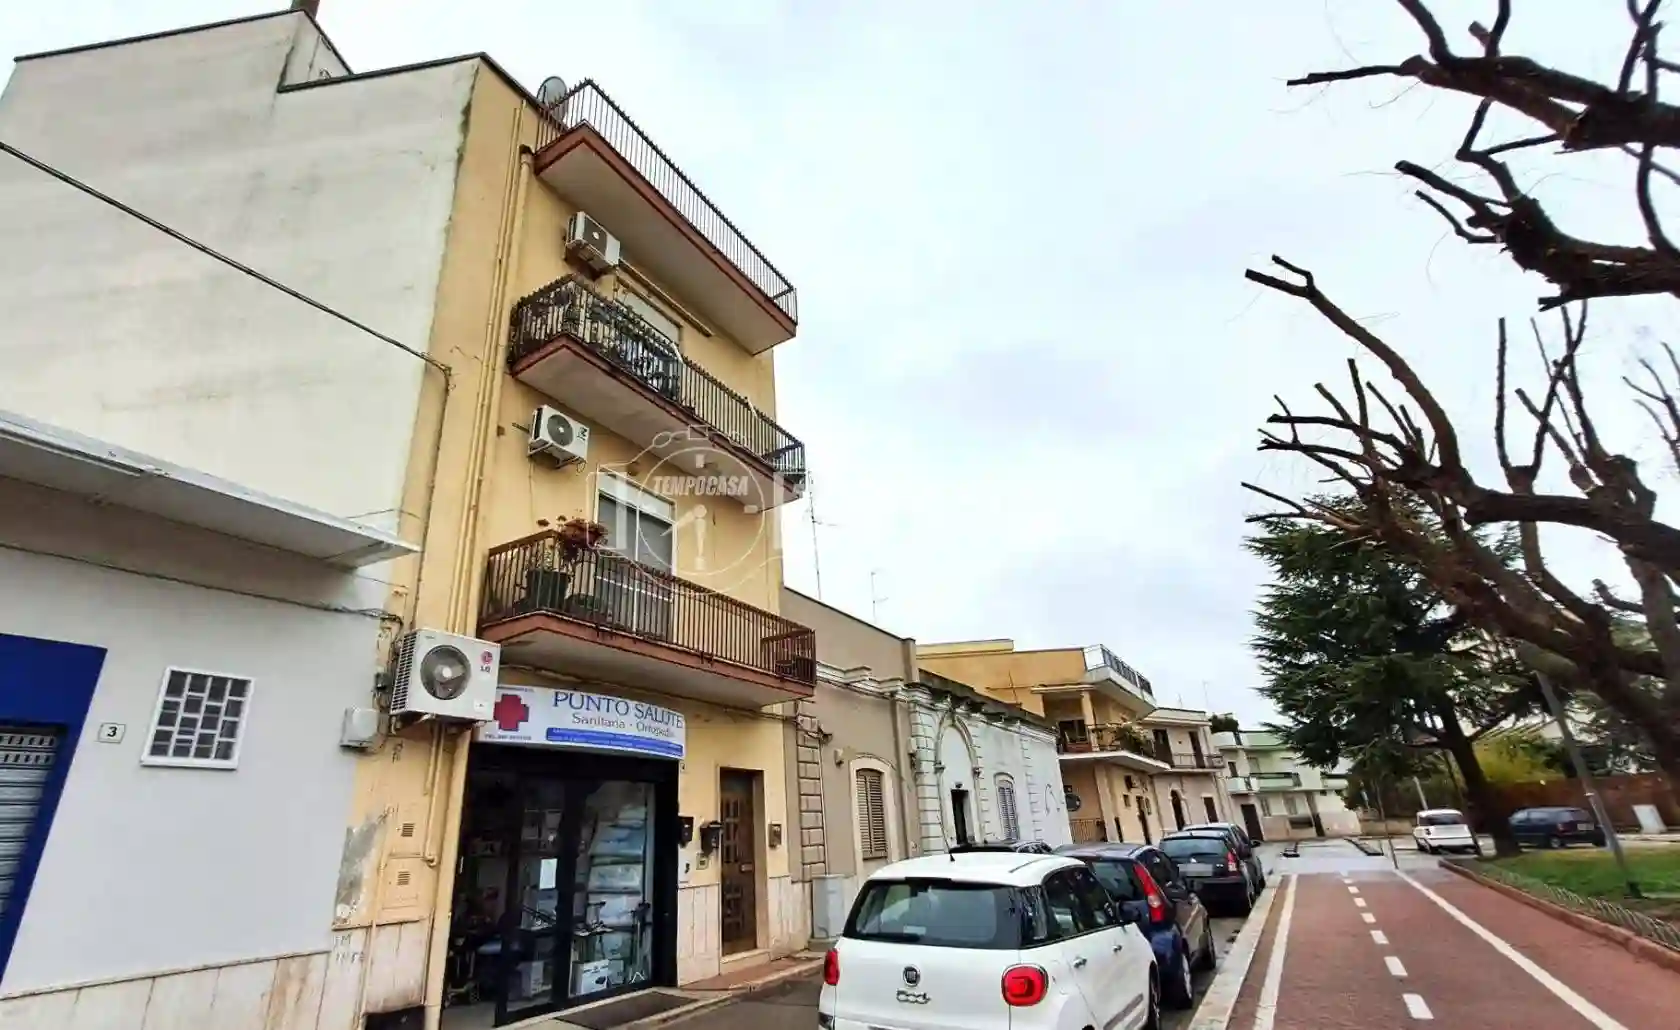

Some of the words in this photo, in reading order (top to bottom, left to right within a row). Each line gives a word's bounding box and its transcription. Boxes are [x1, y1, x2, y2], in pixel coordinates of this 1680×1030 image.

[553, 690, 630, 717] PUNTO
[634, 702, 685, 730] SALUTE
[107, 726, 117, 737] 3
